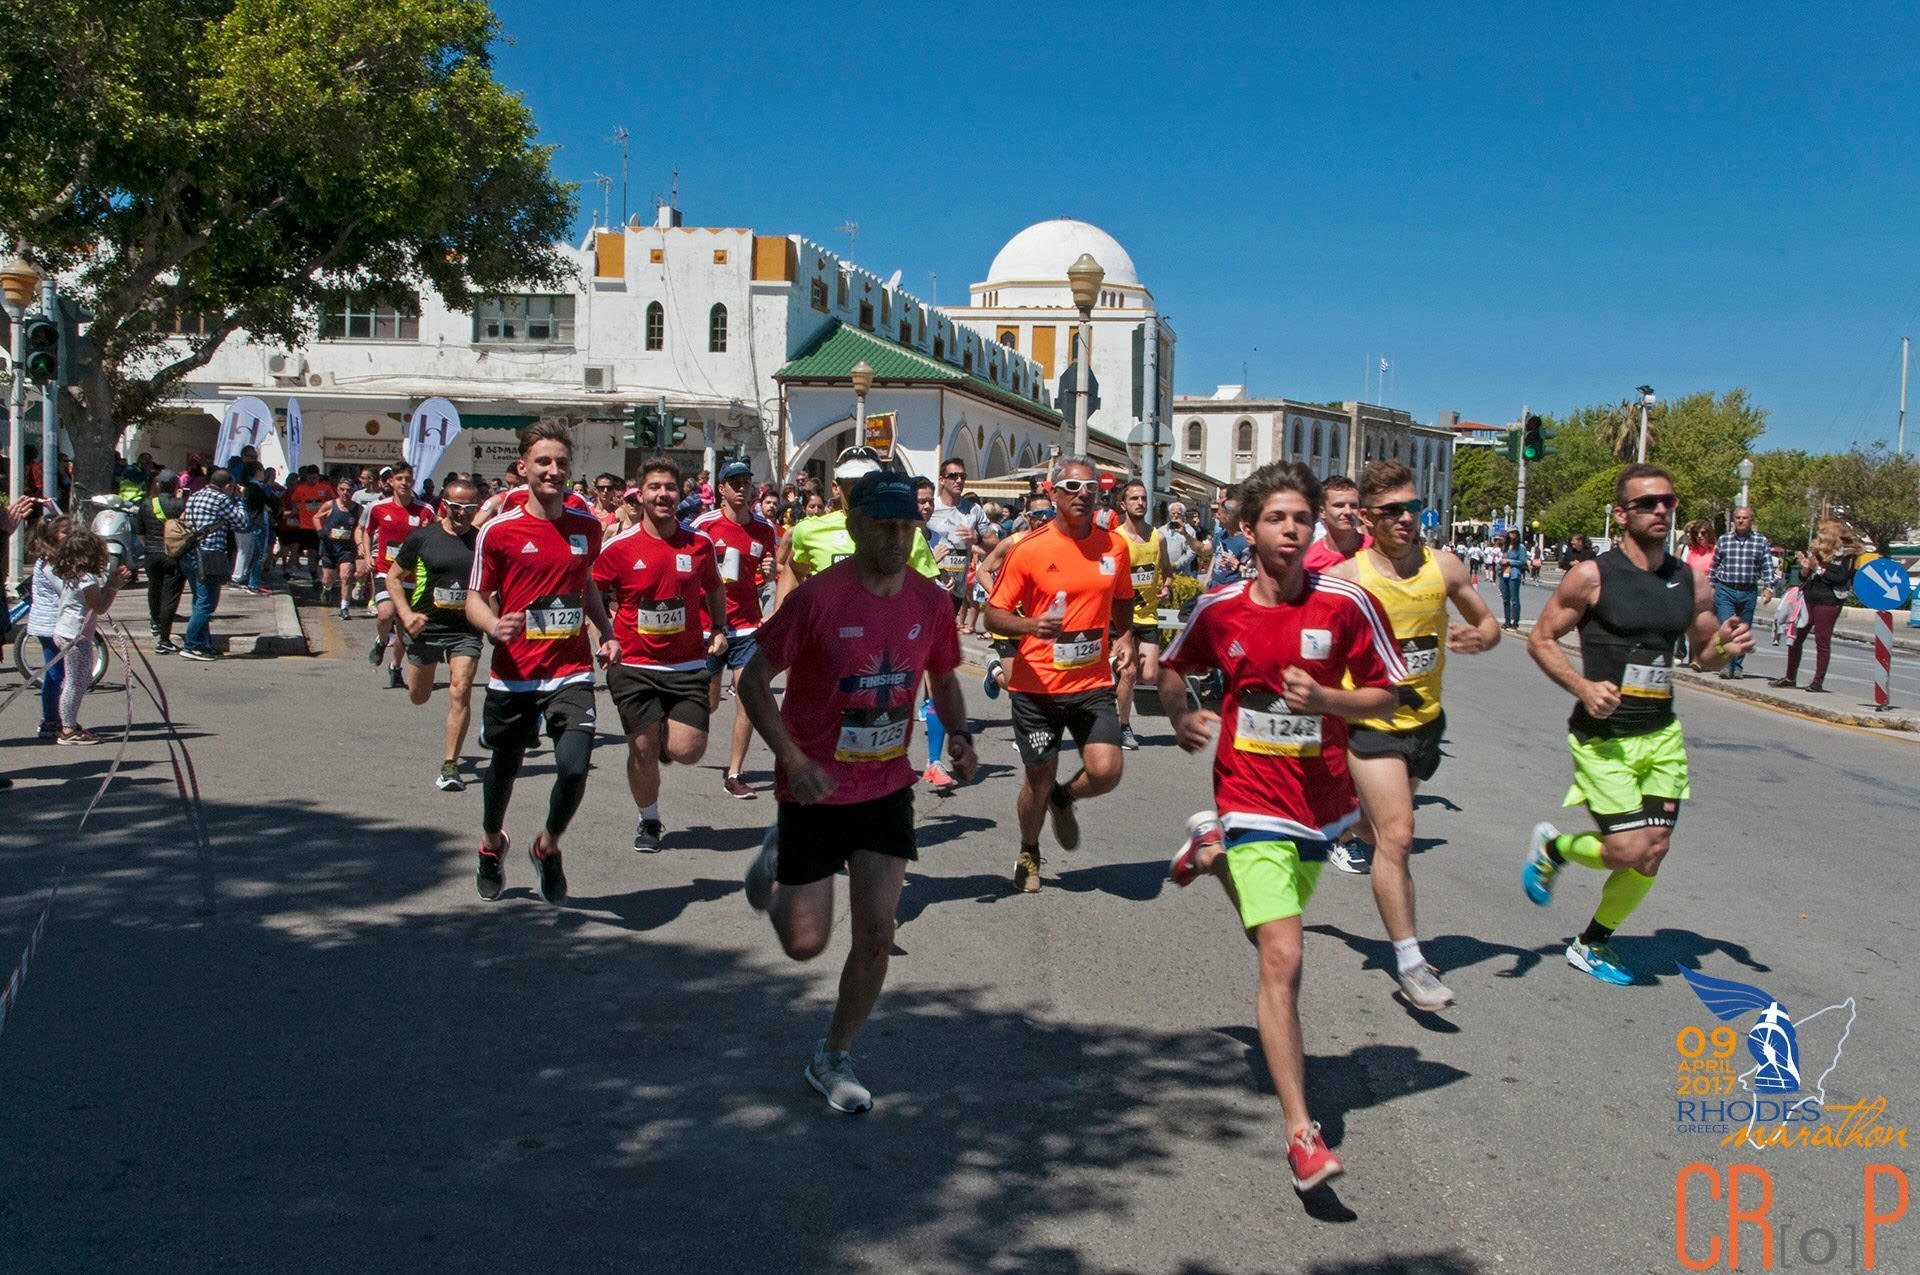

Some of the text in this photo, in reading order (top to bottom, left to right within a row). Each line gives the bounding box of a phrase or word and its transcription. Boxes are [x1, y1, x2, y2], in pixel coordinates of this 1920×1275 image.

[1137, 572, 1154, 581] 1267
[550, 611, 581, 625] 1229
[656, 611, 682, 624] 1241
[1268, 718, 1318, 737] 1242
[870, 723, 905, 747] 1225
